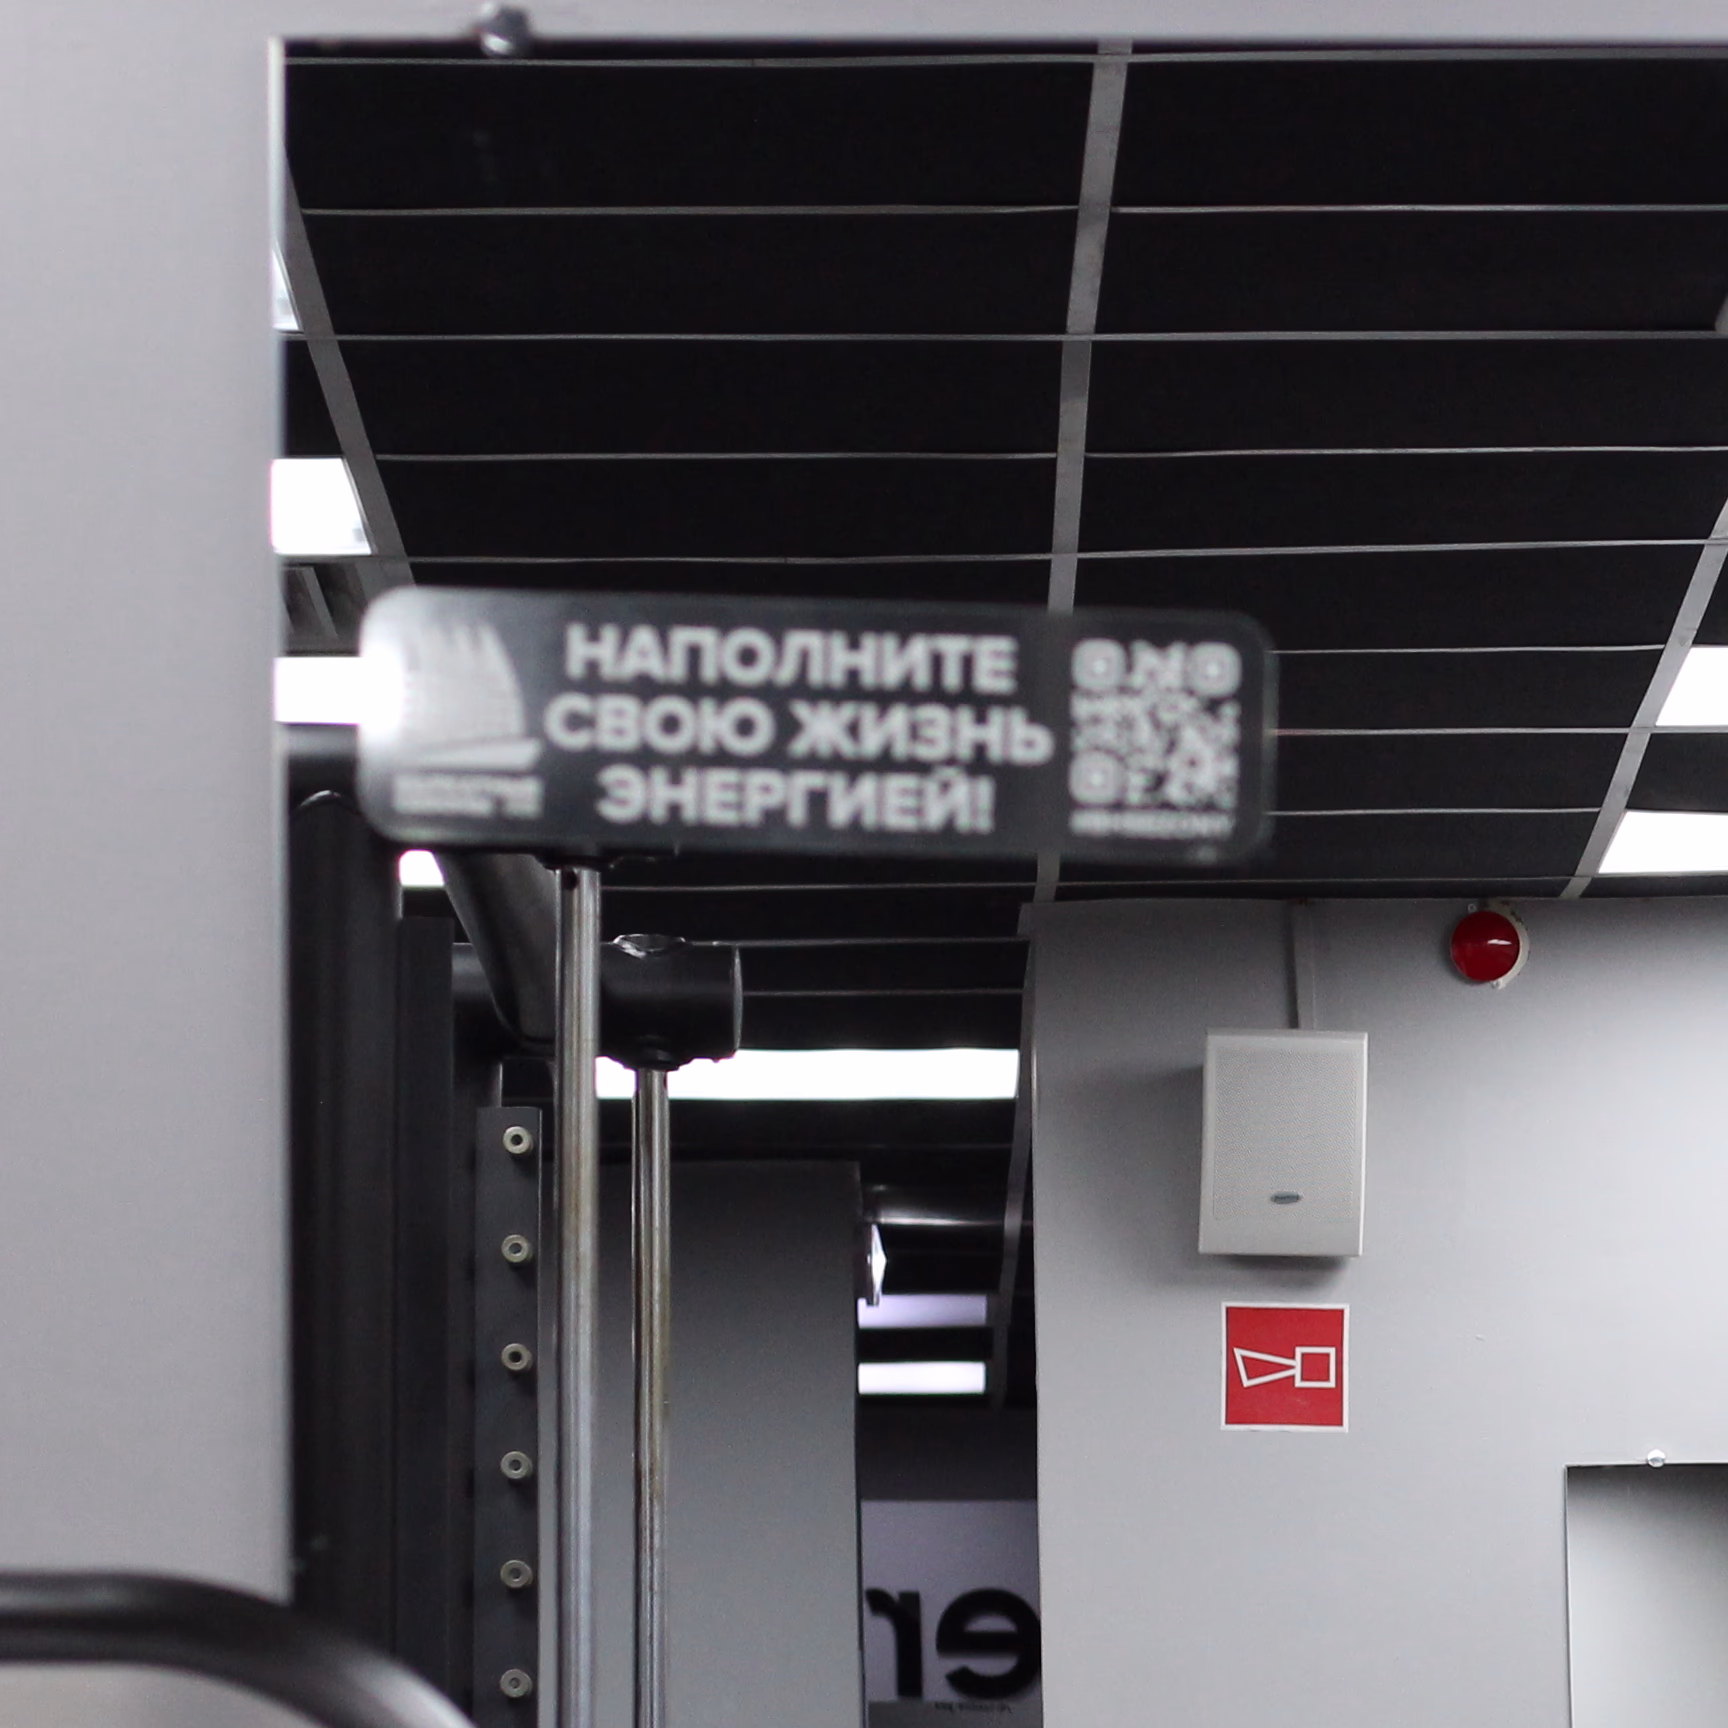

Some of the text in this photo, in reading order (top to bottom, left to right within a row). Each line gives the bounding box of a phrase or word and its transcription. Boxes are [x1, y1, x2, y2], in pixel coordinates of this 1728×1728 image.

[565, 623, 1015, 694] НАПОЛНИТЕ
[545, 692, 1054, 766] СВОЮ ЖИЗНЬ
[599, 763, 995, 833] ЭНЕРГИЕЙ!
